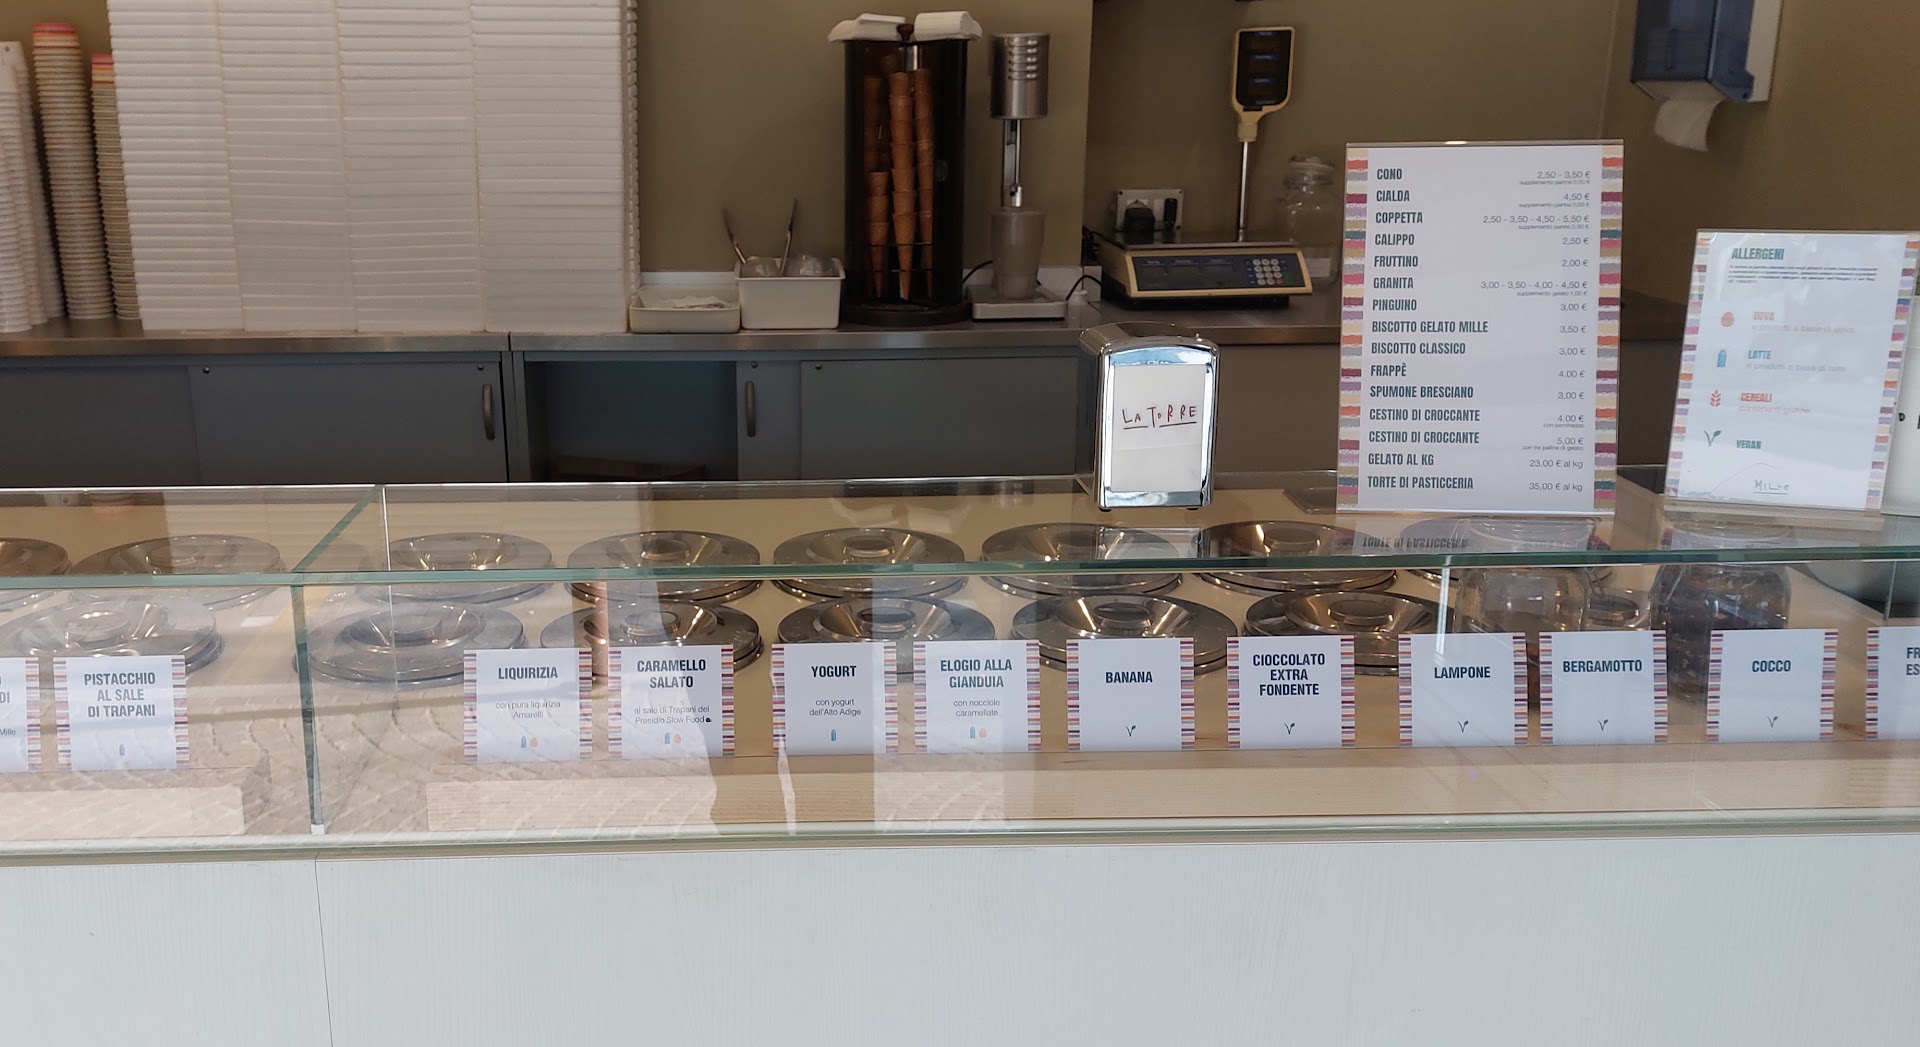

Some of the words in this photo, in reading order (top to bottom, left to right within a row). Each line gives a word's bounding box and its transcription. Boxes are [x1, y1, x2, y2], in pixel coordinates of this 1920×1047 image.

[1376, 168, 1402, 180] CONO
[1564, 171, 1583, 179] 3,50
[1376, 190, 1410, 202] CIALDA
[1564, 193, 1582, 201] 4,50
[1376, 212, 1423, 224] COPPETTA
[1563, 215, 1582, 223] 5,50
[1375, 234, 1415, 245] CALIPPO
[1731, 248, 1784, 260] ALLERGENI
[1374, 256, 1418, 267] FRUTTINO
[1374, 277, 1414, 289] GRANITA
[1481, 281, 1499, 289] 3,00
[1507, 281, 1526, 289] 3,50
[1534, 281, 1553, 289] 4,00
[1561, 281, 1580, 289] 4,50
[1372, 299, 1417, 310] PINGUINO
[1560, 303, 1579, 312] 3,00
[1372, 321, 1417, 333] BISCOTTO
[1420, 321, 1455, 333] GELATO
[1459, 321, 1488, 333] MILLE
[1560, 325, 1579, 334] 3,50
[1580, 325, 1587, 333] €
[1371, 343, 1416, 354] BISCOTTO
[1420, 343, 1466, 354] CLASSICO
[1559, 348, 1578, 356] 3,00
[1748, 350, 1772, 360] LATTE
[1370, 363, 1407, 377] FRAPPÈ
[1558, 370, 1577, 378] 4,00
[1370, 386, 1417, 398] SPUMONE
[1420, 386, 1473, 398] BRESCIANO
[1558, 391, 1576, 400] 3,00
[1578, 391, 1584, 399] €
[1740, 393, 1772, 403] CEREALI
[1122, 409, 1141, 423] LA
[1369, 409, 1408, 420] CESTINO
[1411, 409, 1421, 421] DI
[1424, 409, 1480, 421] CROCCANTE
[1369, 431, 1408, 443] CESTINO
[1410, 431, 1421, 443] DI
[1423, 432, 1479, 444] CROCCANTE
[1557, 437, 1576, 445] 5,00
[1736, 440, 1762, 449] VEGAN
[1368, 453, 1403, 465] GELATO
[1406, 454, 1418, 465] AL
[1421, 454, 1434, 466] KG
[1572, 460, 1583, 469] kg
[1367, 476, 1398, 488] TORTE
[1399, 476, 1409, 488] DI
[1412, 476, 1473, 489] PASTICCERIA
[1572, 483, 1582, 492] kg
[637, 659, 706, 672] CARAMELLO
[940, 660, 981, 672] ELOGIO
[984, 659, 1012, 671] ALLA
[1253, 653, 1325, 666] CIOCCOLATO
[811, 665, 857, 678] YOGURT
[1563, 660, 1642, 673] BERGAMOTTO
[1752, 660, 1791, 672] COCCO
[498, 667, 558, 680] LIQUIRIZIA
[1105, 671, 1153, 684] BANANA
[1270, 669, 1308, 681] EXTRA
[1434, 666, 1491, 679] LAMPONE
[84, 672, 156, 686] PISTACCHIO
[649, 675, 693, 688] SALATO
[949, 676, 1004, 688] GIANDUIA
[97, 690, 112, 702] AL
[115, 689, 144, 701] SALE
[1259, 684, 1319, 696] FONDENTE
[831, 698, 854, 708] yogurt
[88, 706, 100, 718] DI
[103, 704, 156, 717] TRAPANI
[668, 706, 696, 714] Trapani
[840, 708, 861, 718] Adige
